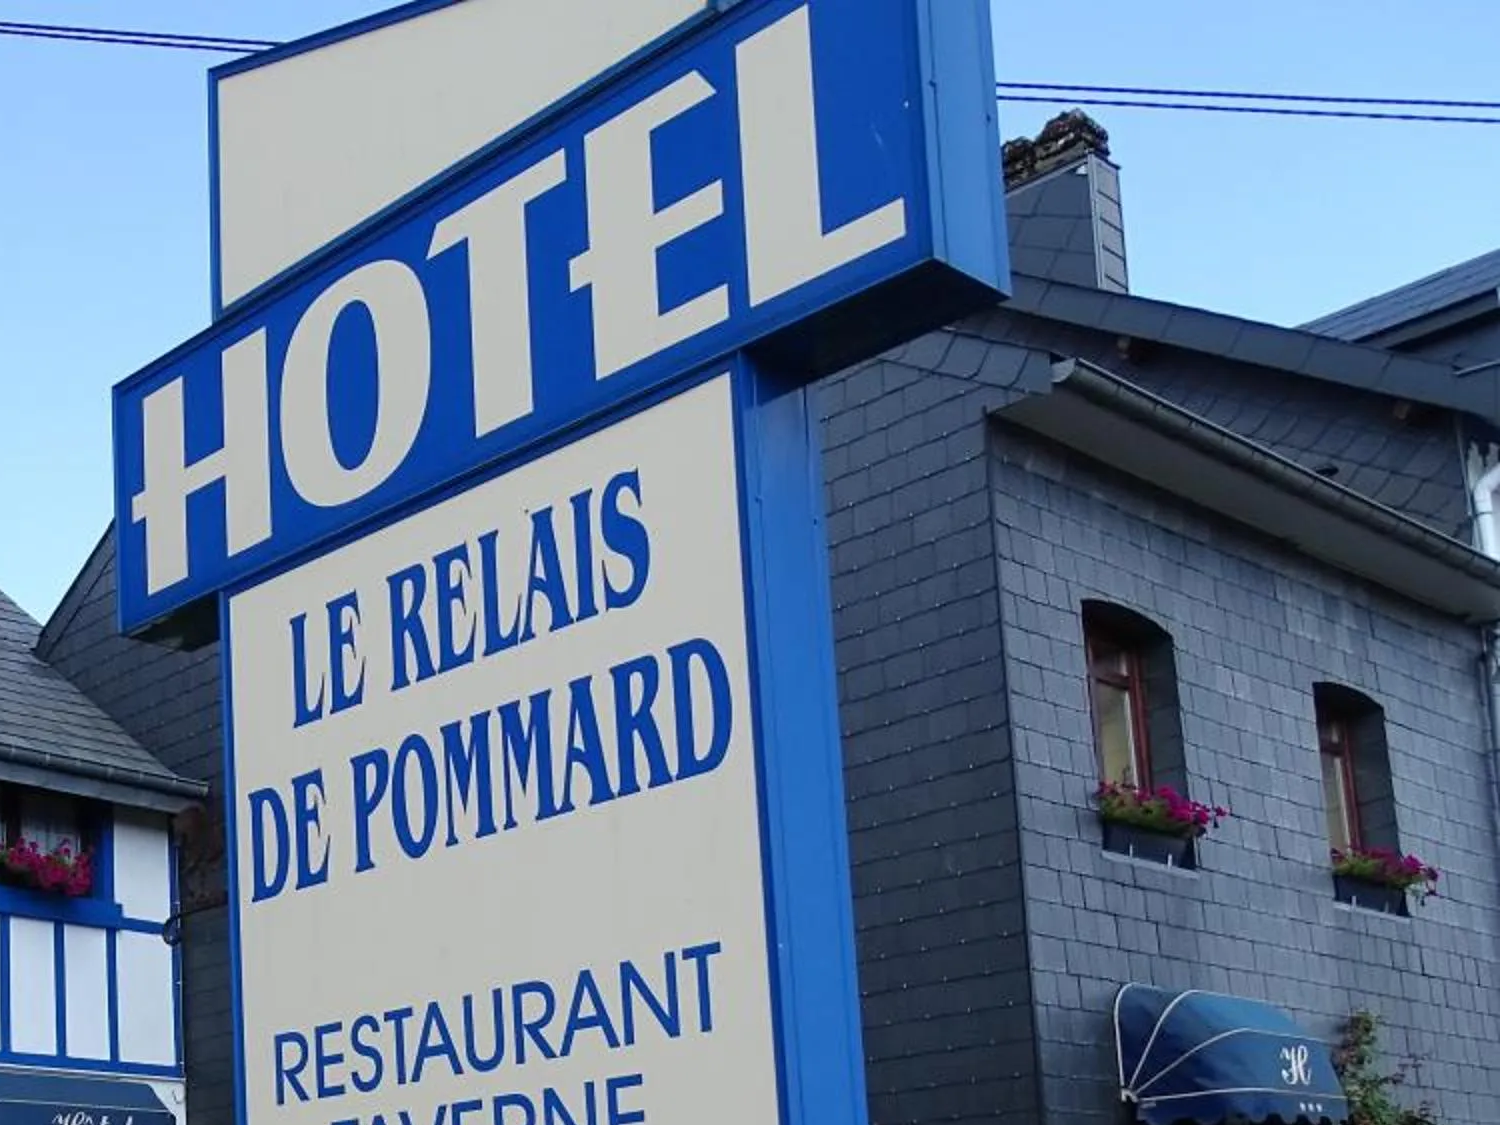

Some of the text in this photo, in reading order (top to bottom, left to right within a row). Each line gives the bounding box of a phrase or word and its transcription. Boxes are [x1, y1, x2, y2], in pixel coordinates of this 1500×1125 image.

[132, 3, 907, 598] HOTEL
[289, 467, 651, 729] LE RELAIS
[247, 637, 733, 903] DE POMMARD
[273, 940, 722, 1106] RESTAURANT
